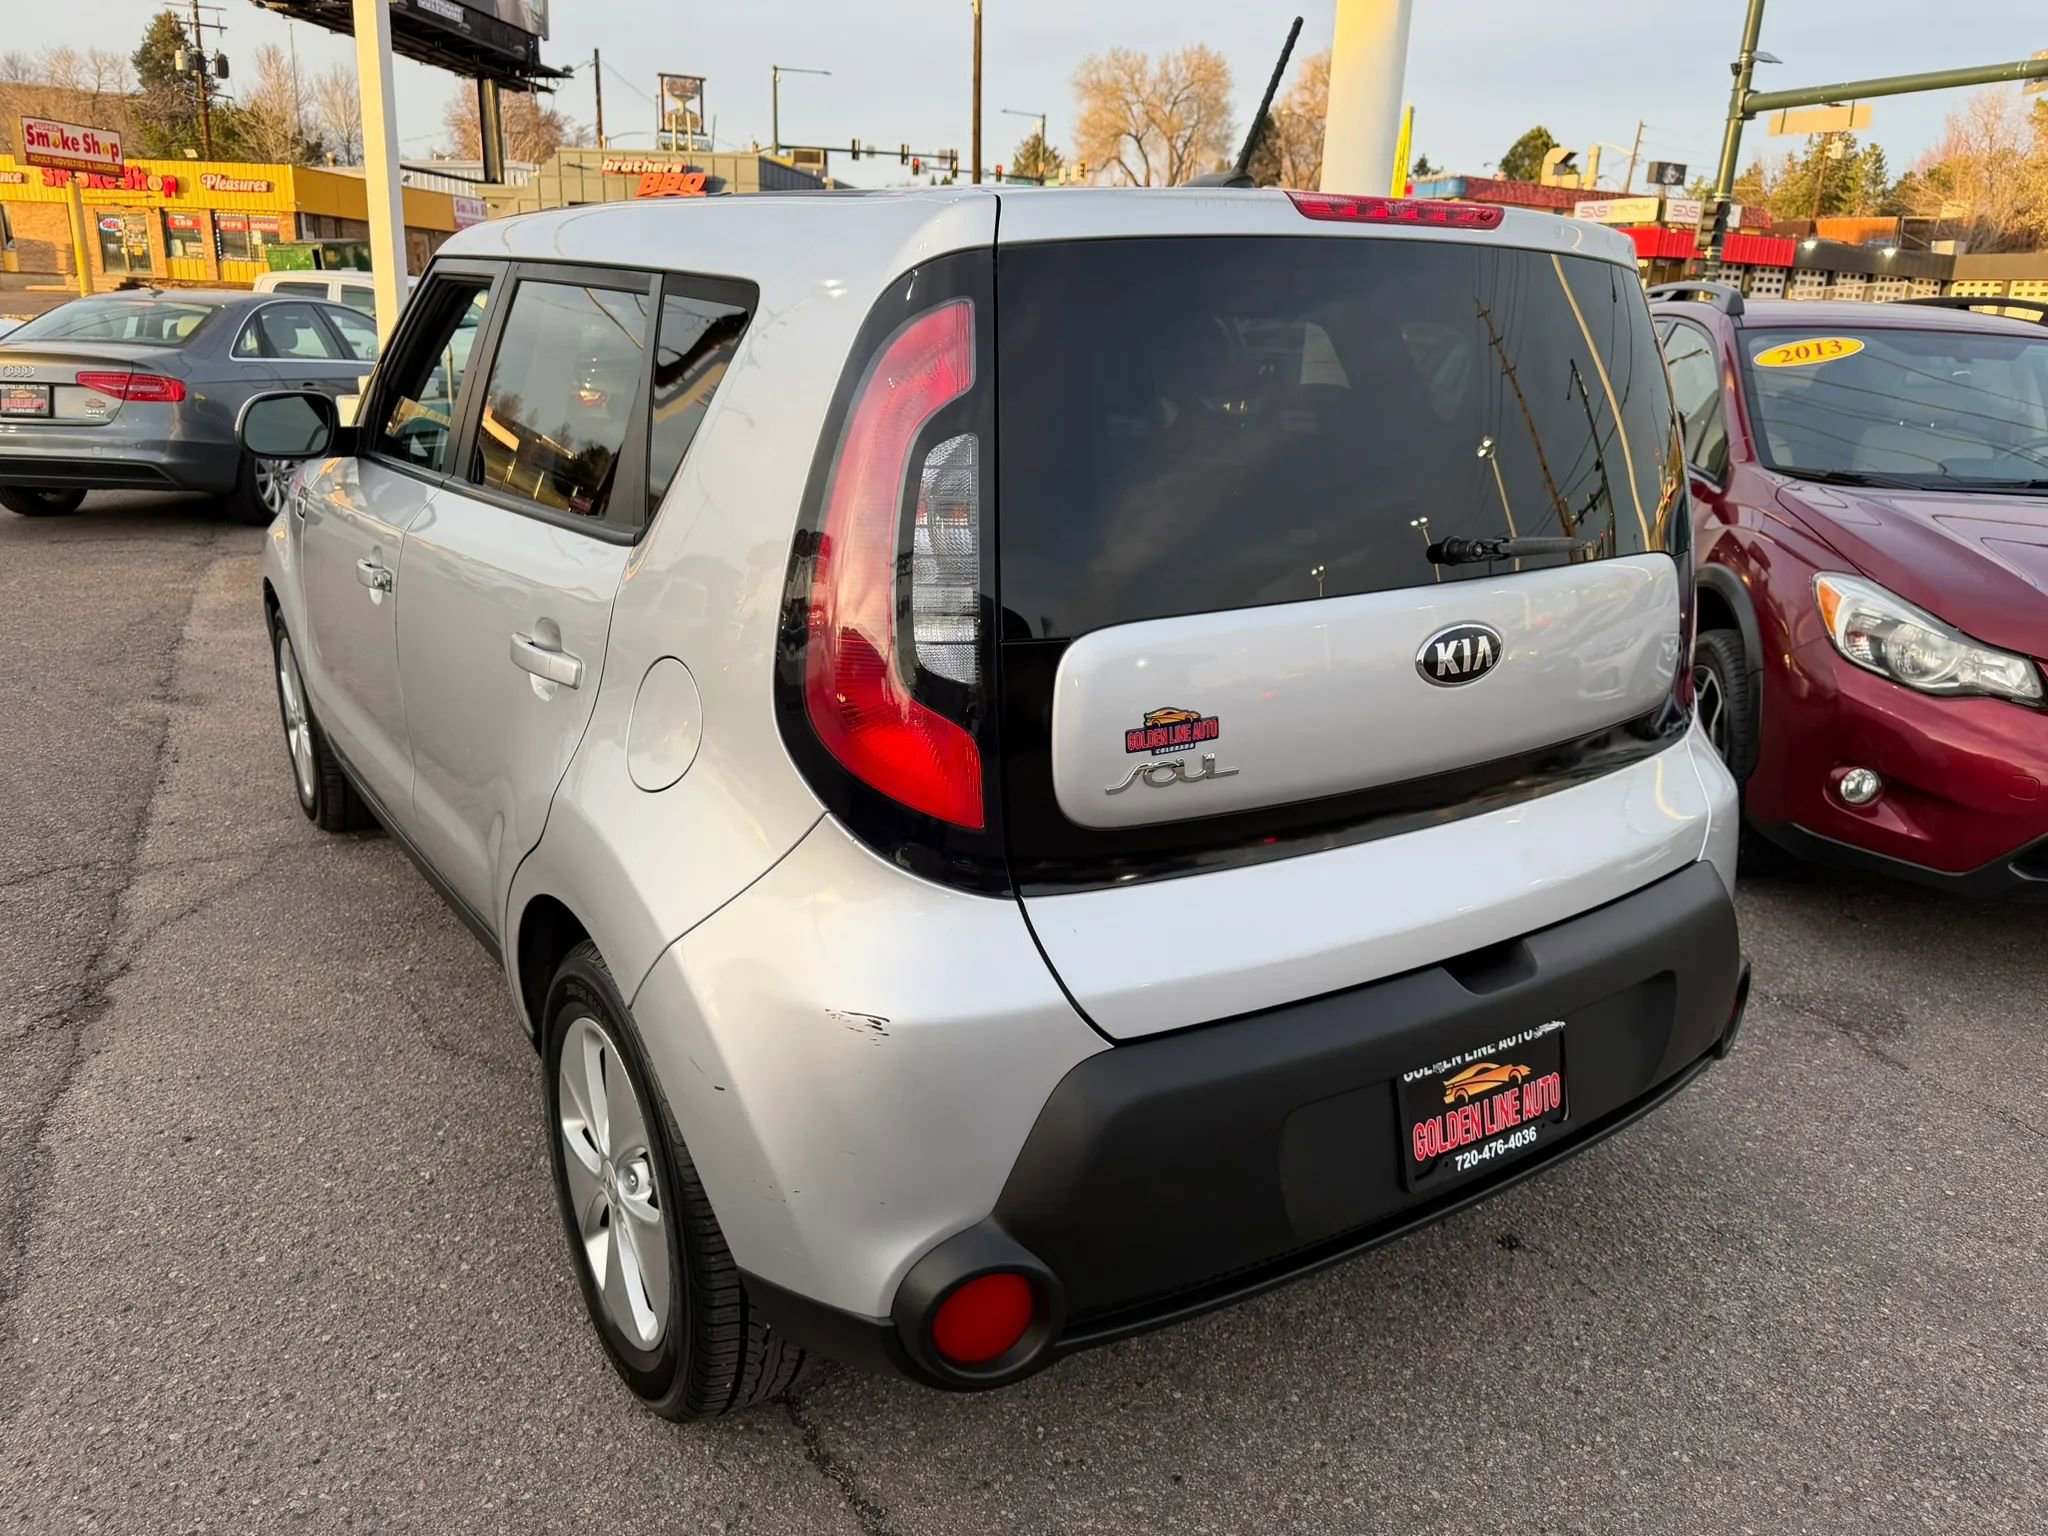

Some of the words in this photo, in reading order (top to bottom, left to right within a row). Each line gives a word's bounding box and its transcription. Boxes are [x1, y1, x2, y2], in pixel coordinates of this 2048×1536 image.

[26, 124, 80, 152] Smoke
[82, 132, 119, 162] Shop
[200, 173, 270, 192] Pleasures
[638, 172, 707, 196] BBQ
[1777, 340, 1843, 364] 2013
[1434, 634, 1493, 677] KIA
[1127, 727, 1169, 751] GOLDEN
[1169, 723, 1192, 744] LINE
[1193, 719, 1218, 741] AUTO
[1155, 742, 1195, 755] COLORADO
[1412, 1101, 1484, 1162] GOLDEN
[1484, 1087, 1521, 1136] LINE
[1523, 1071, 1561, 1121] AUTO
[1455, 1126, 1537, 1172] 720-476-4036
